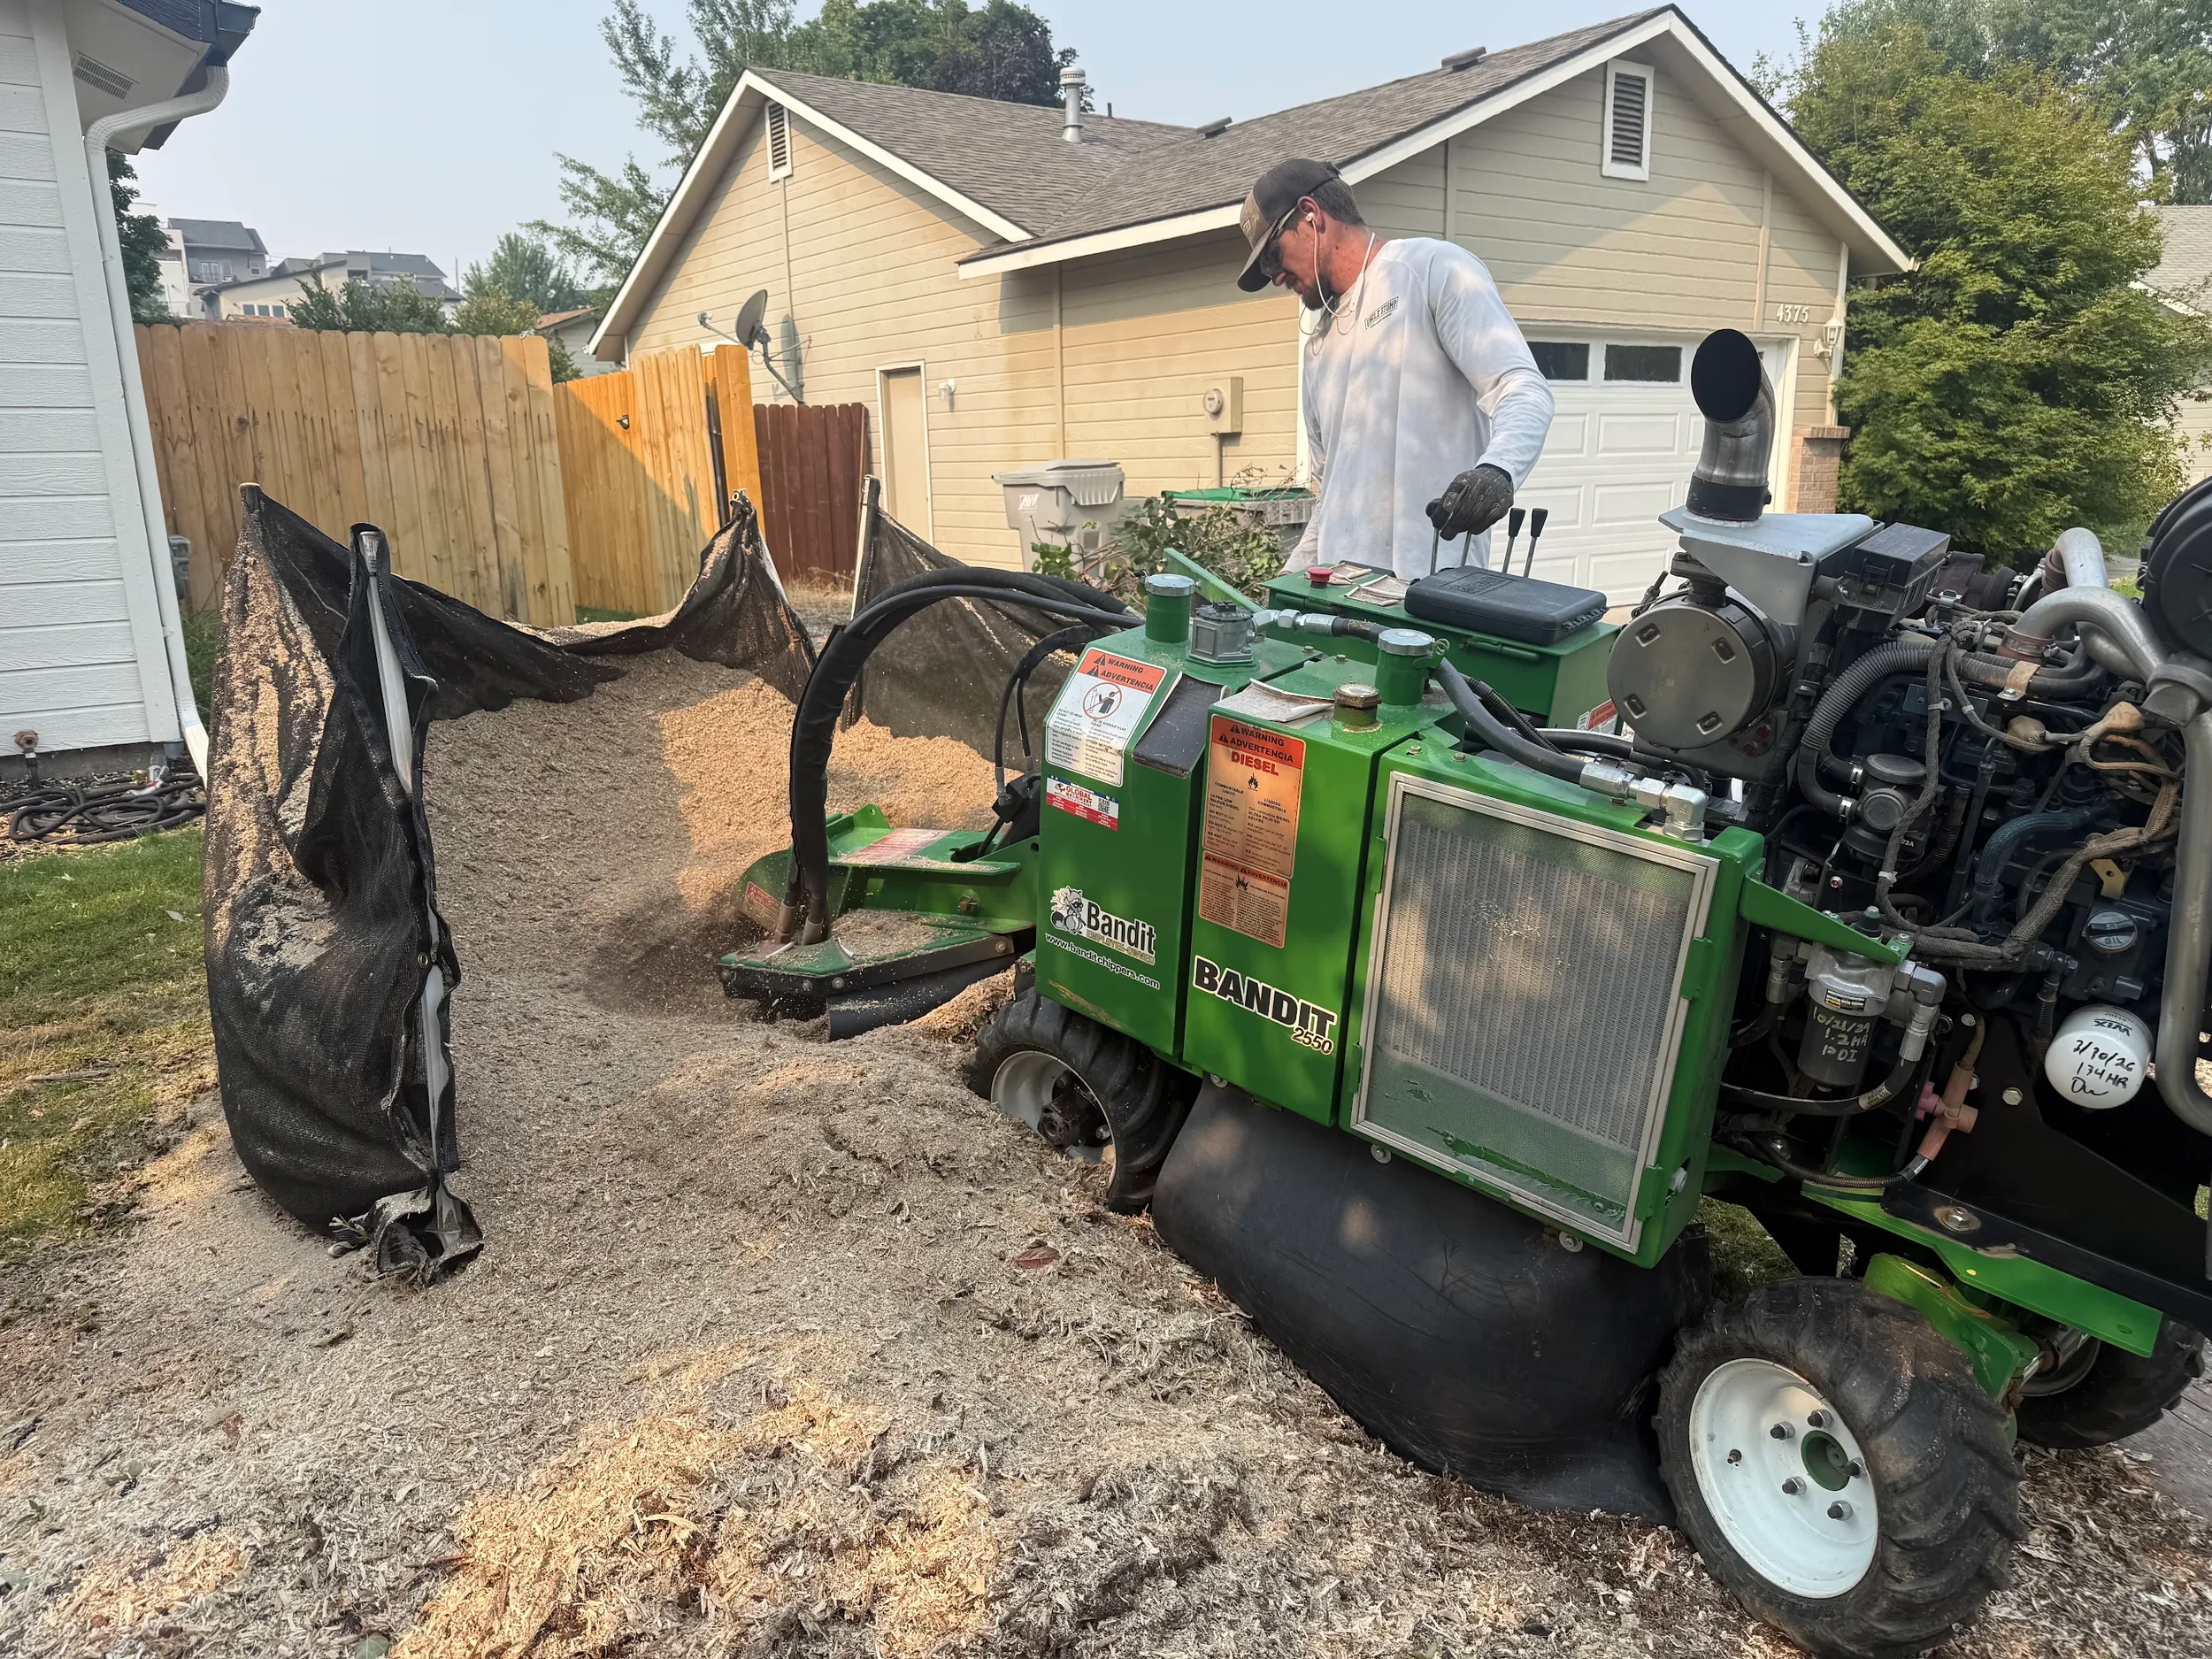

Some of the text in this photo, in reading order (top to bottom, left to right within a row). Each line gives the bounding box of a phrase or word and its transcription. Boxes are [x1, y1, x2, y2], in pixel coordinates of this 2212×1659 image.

[1777, 304, 1809, 323] 4375
[1108, 658, 1144, 673] WARNING
[1101, 671, 1153, 690] ADVERTENCIA
[1230, 736, 1294, 764] ADVERTENCIA
[1240, 726, 1285, 748] WARNING
[1231, 749, 1279, 777] DIESEL
[1066, 786, 1092, 800] GLOBAL
[1211, 858, 1287, 887] WARNING ADVERTENCIA
[1087, 902, 1156, 955] Bandit
[1046, 933, 1160, 989] www.banditchippers.com
[1194, 957, 1336, 1038] BANDIT
[1292, 1027, 1333, 1054] 2550
[2093, 1021, 2130, 1037] WIX
